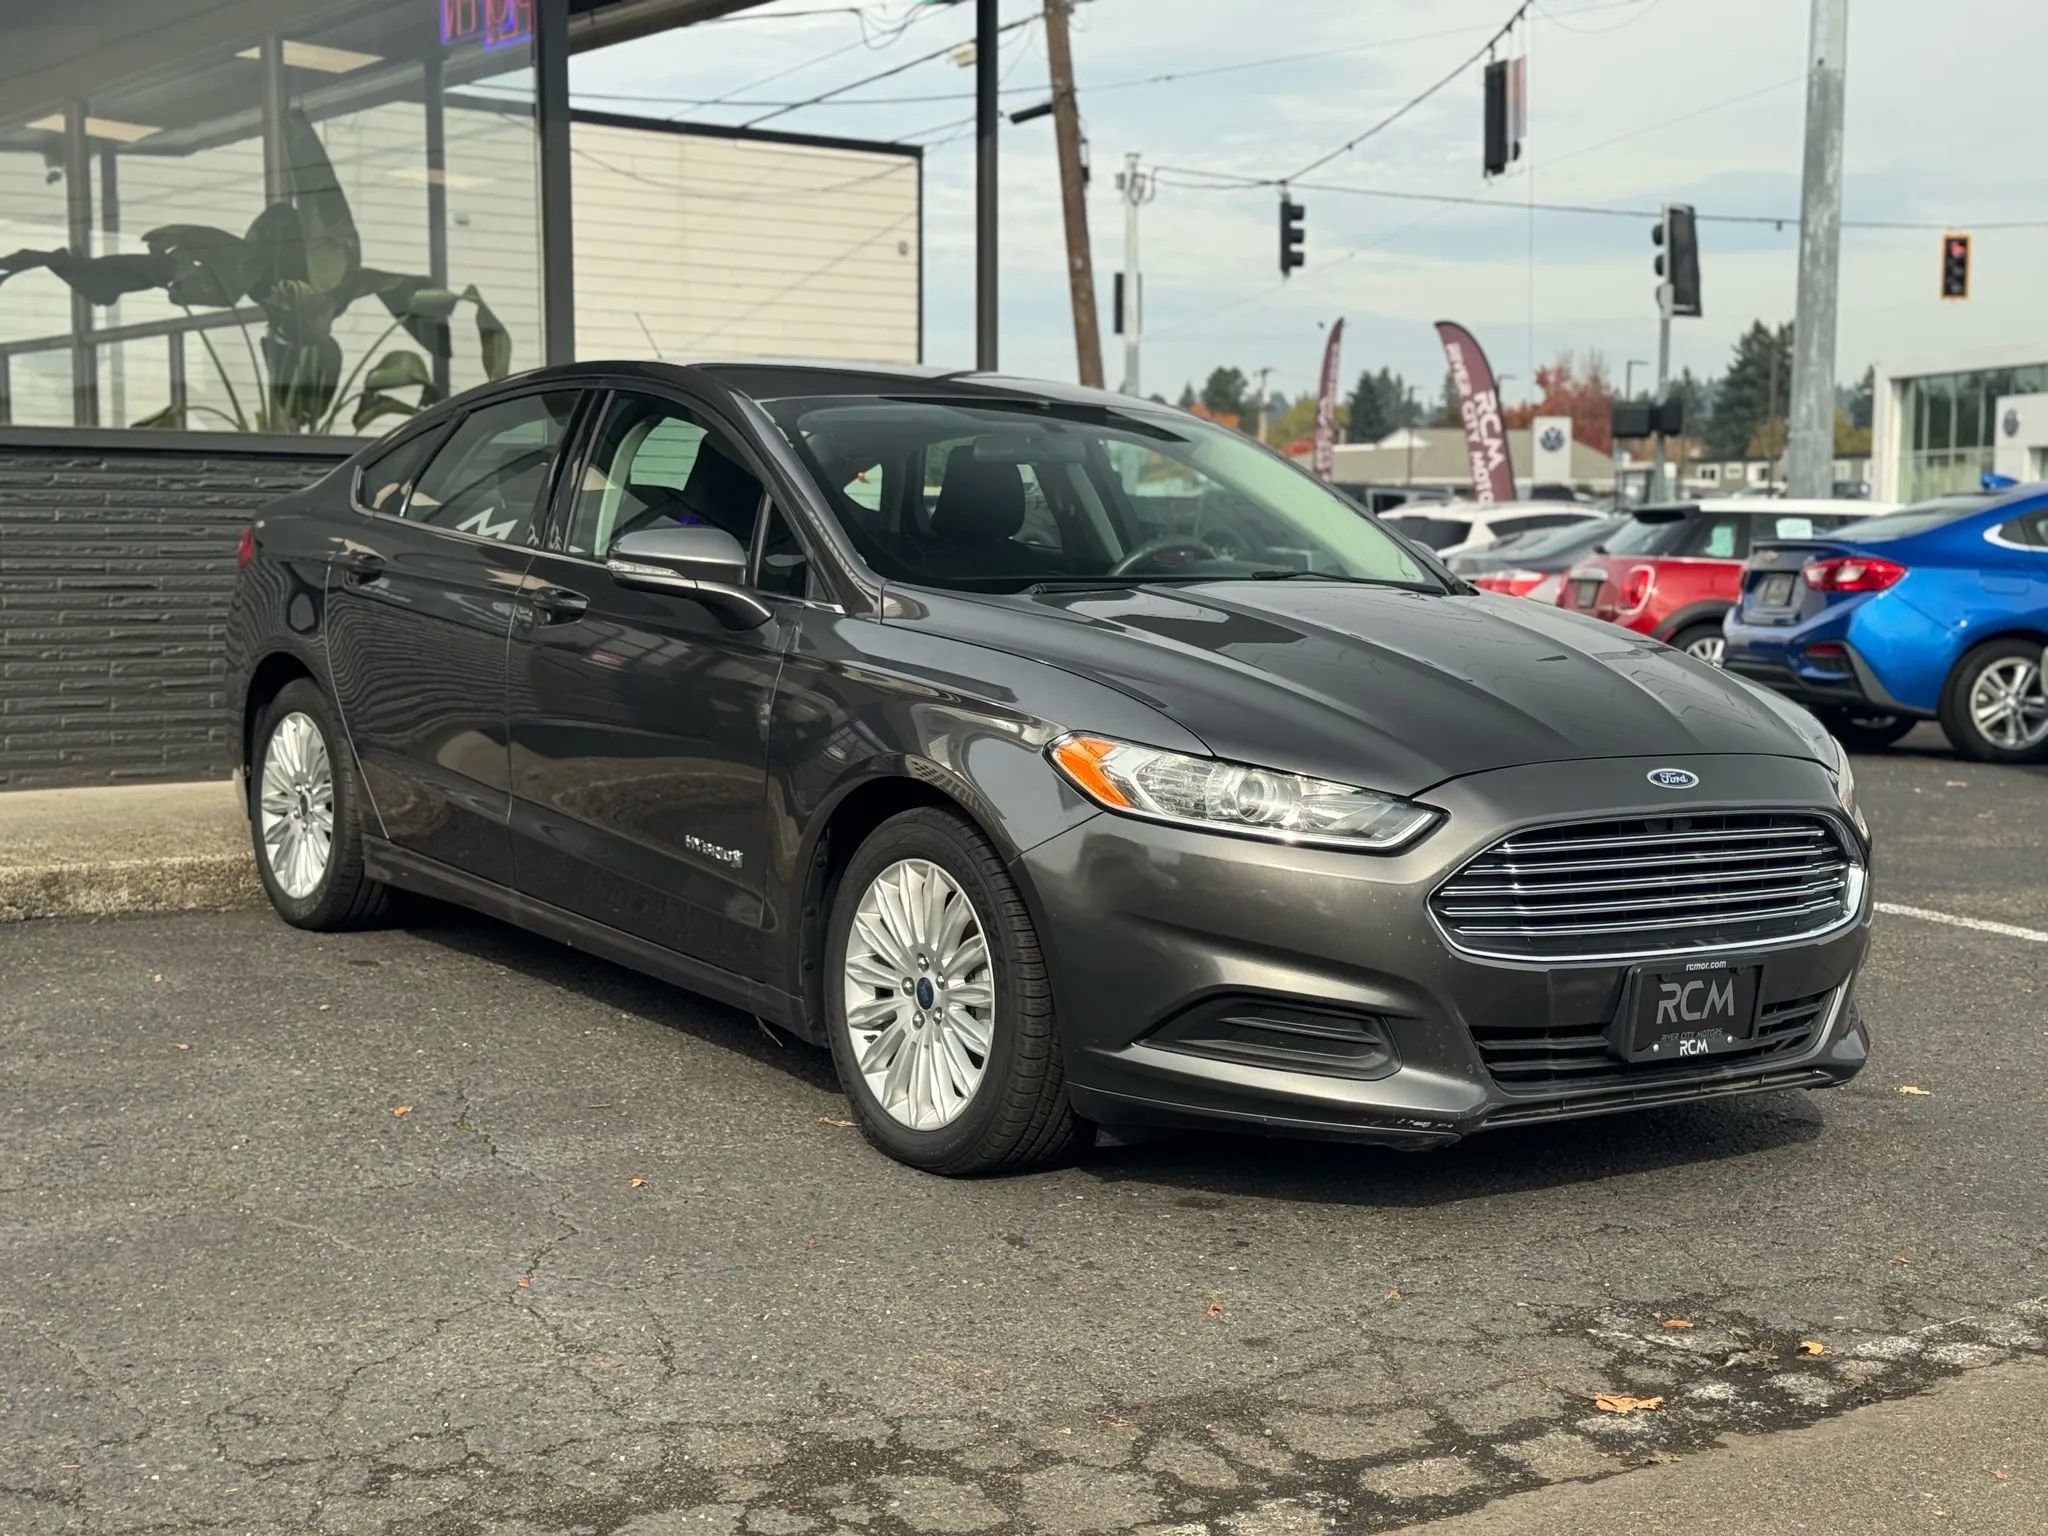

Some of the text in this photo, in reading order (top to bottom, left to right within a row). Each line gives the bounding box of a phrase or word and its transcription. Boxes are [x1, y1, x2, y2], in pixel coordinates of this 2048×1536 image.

[1461, 400, 1481, 443] CITY
[1473, 389, 1506, 471] RCM
[1659, 772, 1689, 784] Ford
[1686, 960, 1727, 972] rcmor.com
[1656, 978, 1735, 1025] RCM
[1679, 1038, 1709, 1057] RCM
